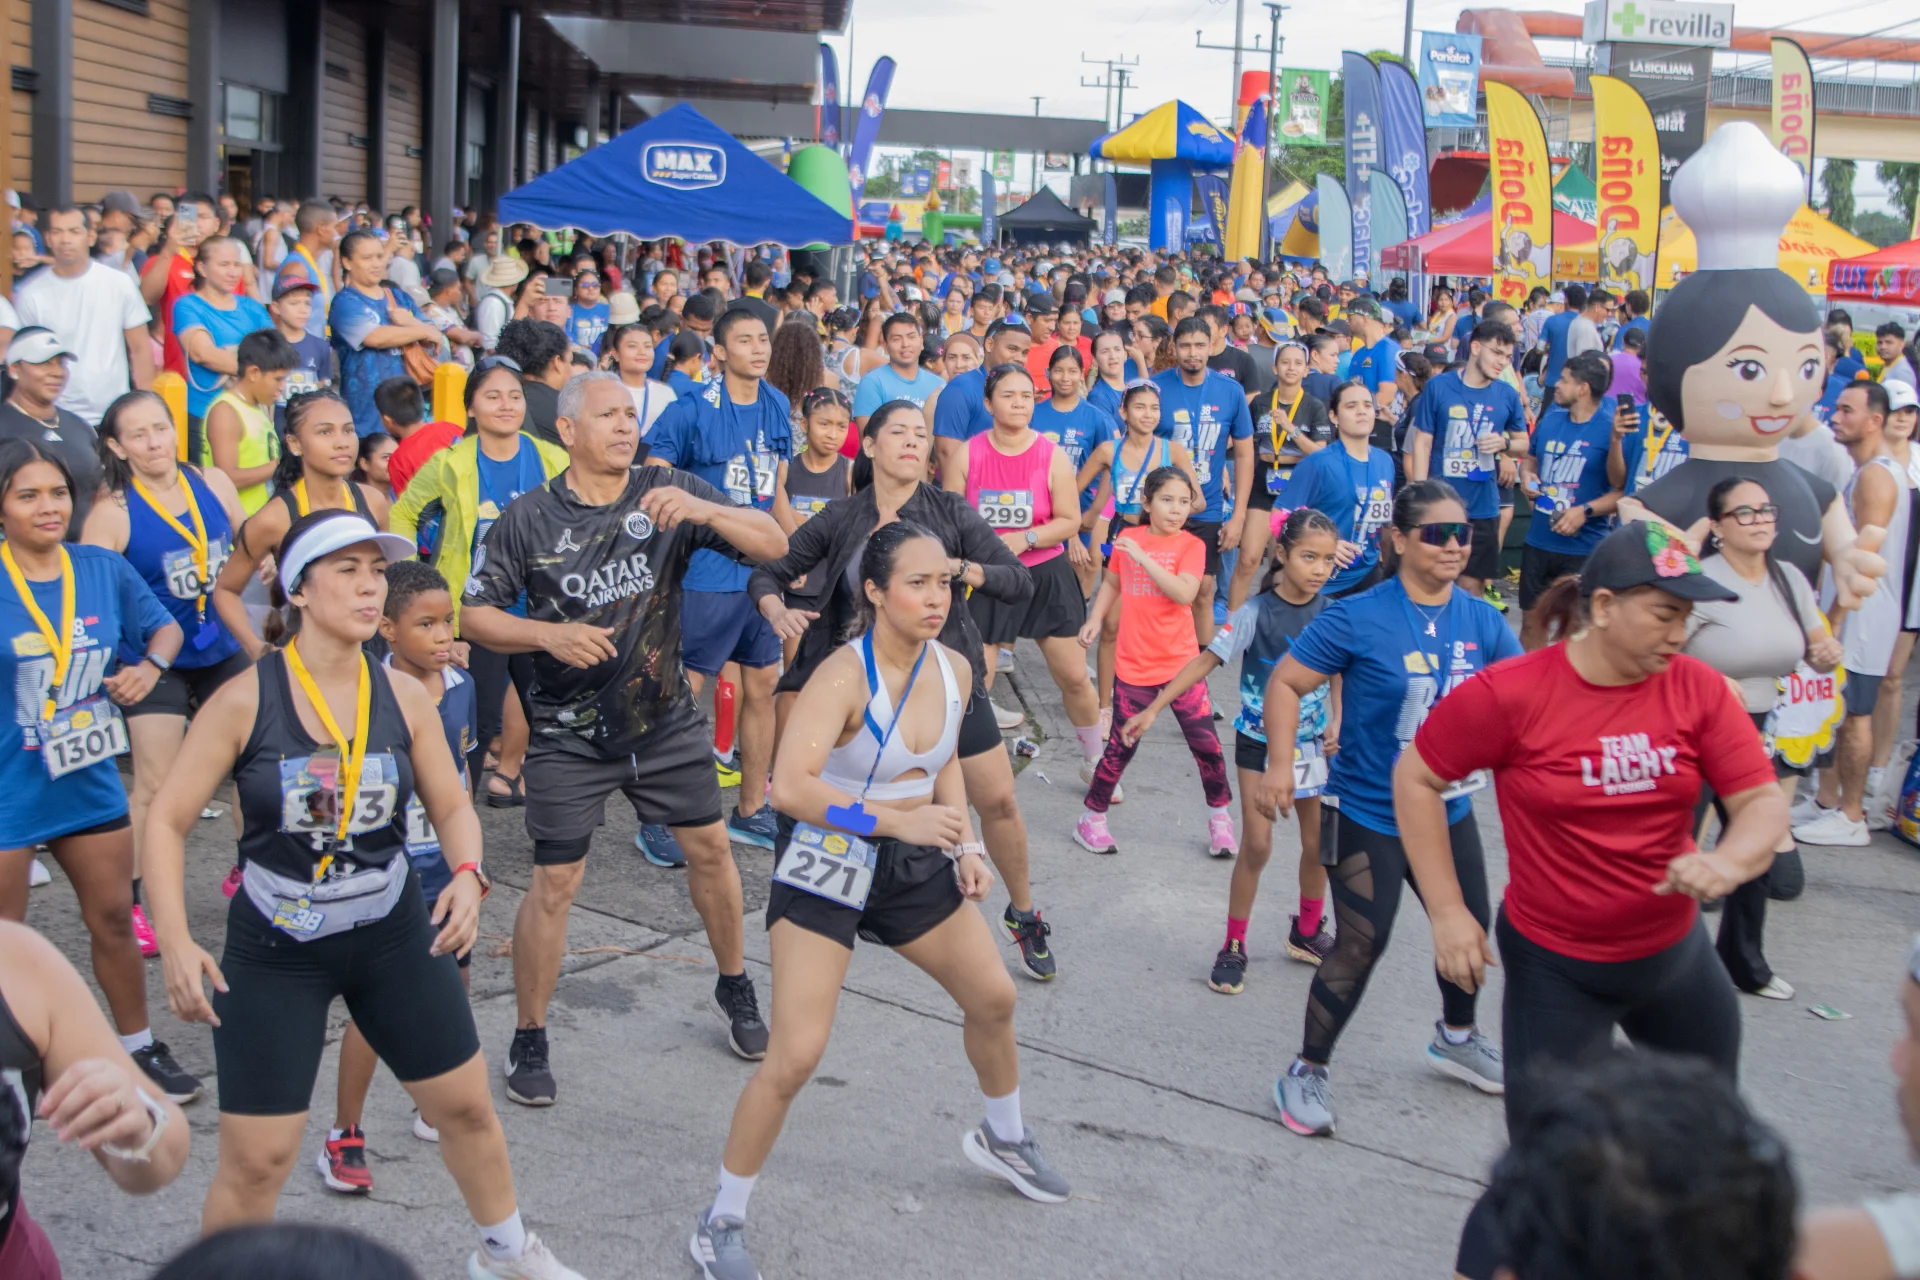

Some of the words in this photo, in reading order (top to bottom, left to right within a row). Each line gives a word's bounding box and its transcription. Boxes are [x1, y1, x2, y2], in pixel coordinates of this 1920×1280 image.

[1649, 13, 1725, 38] revilla
[1430, 49, 1470, 64] Panalat
[1629, 60, 1643, 73] LA
[1645, 61, 1694, 76] SICILIANA
[1655, 113, 1685, 132] alat
[655, 150, 713, 172] MAX
[1833, 264, 1868, 293] LUX
[1065, 429, 1076, 439] 38
[1172, 424, 1221, 450] RUN
[732, 468, 769, 491] 127
[1541, 453, 1587, 484] RUN
[984, 507, 1028, 524] 299
[1369, 503, 1391, 519] 88
[560, 553, 652, 599] QATAR
[586, 574, 654, 608] AIRWAYS
[1452, 640, 1465, 658] 8
[15, 647, 112, 727] RUN
[52, 724, 119, 769] 1301
[1598, 732, 1649, 758] TEAM
[1580, 746, 1677, 787] LACHY
[788, 850, 858, 898] 271
[292, 908, 325, 931] 38
